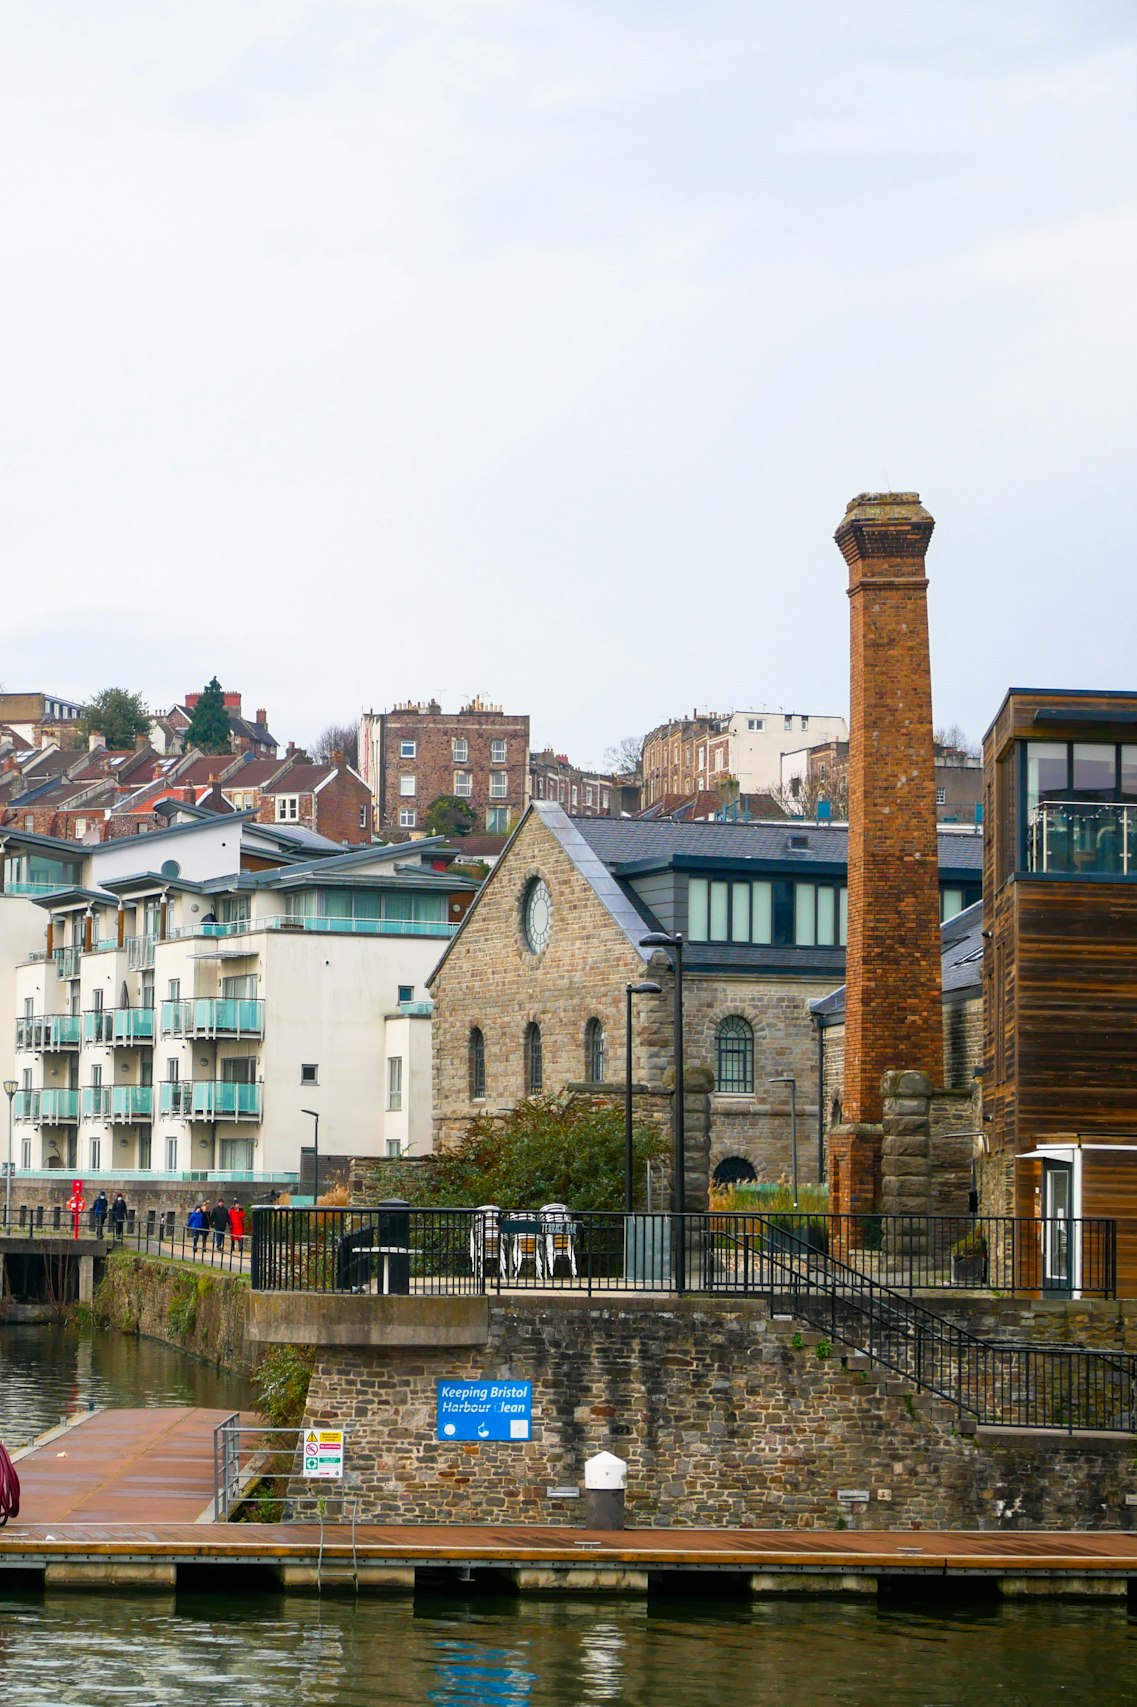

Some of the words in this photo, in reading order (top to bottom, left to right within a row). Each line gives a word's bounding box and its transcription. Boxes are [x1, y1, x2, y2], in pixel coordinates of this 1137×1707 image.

[441, 1386, 488, 1401] Keeping
[490, 1386, 528, 1398] Bristol
[442, 1401, 491, 1413] Harbour
[493, 1401, 526, 1413] lean
